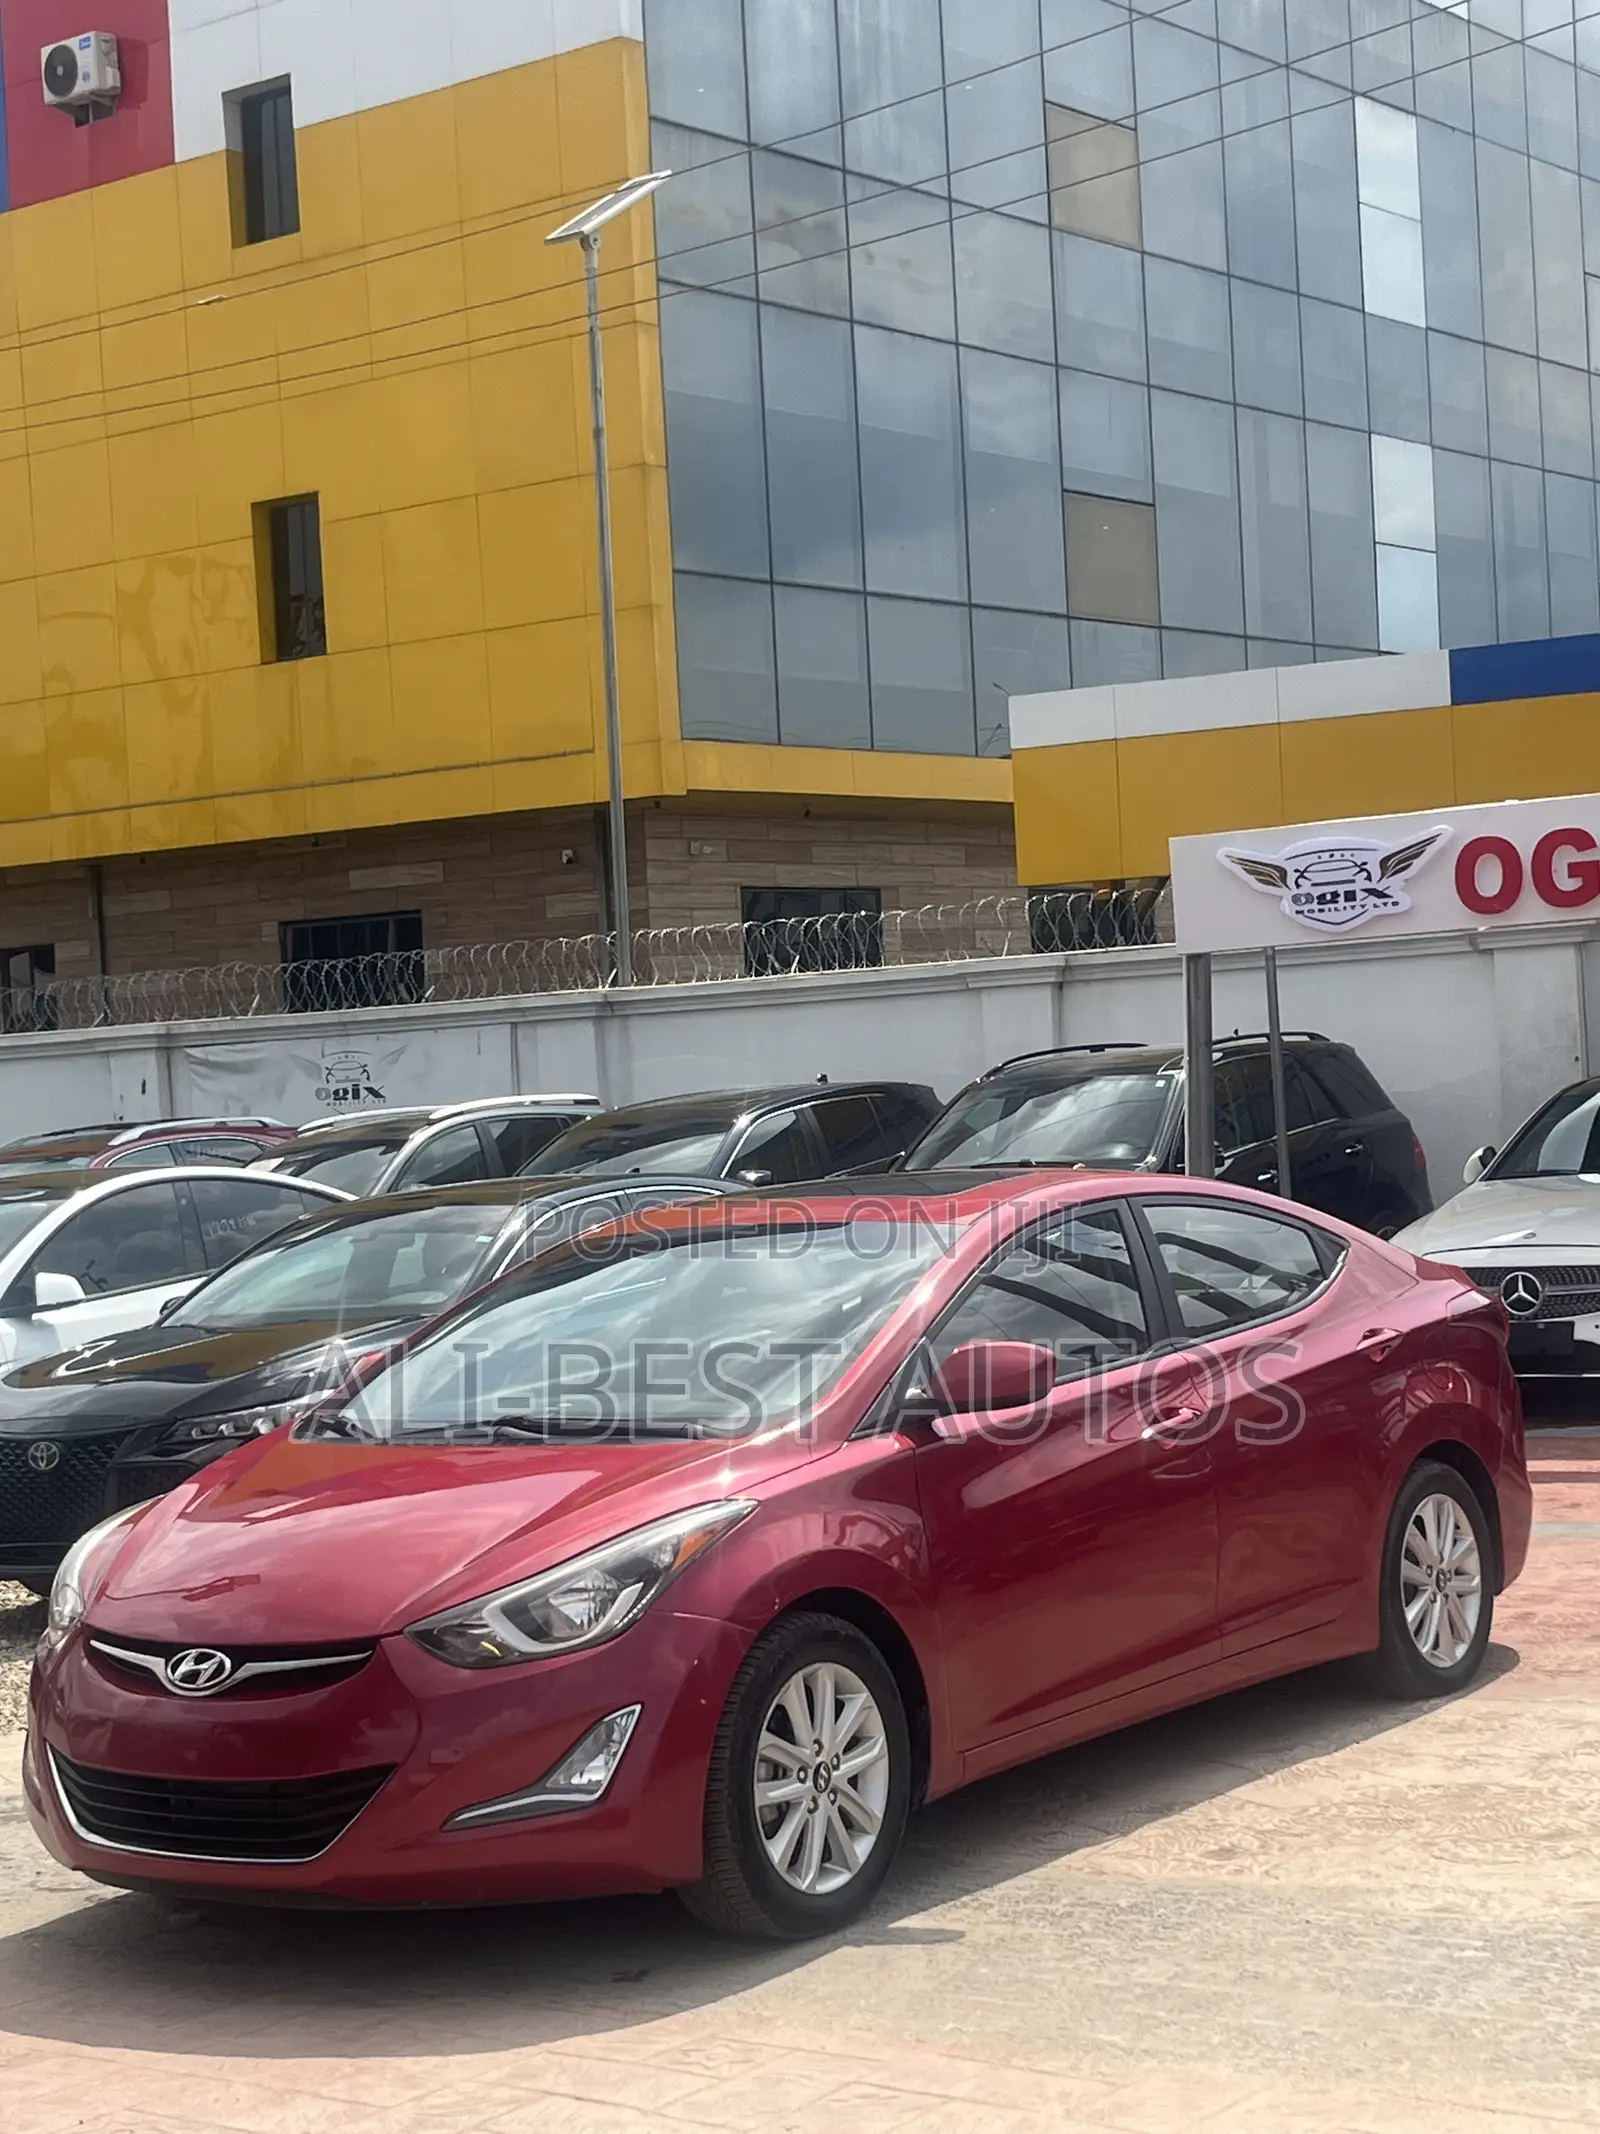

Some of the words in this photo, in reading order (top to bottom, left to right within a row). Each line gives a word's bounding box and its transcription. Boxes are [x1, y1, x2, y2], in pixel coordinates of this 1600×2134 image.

[1455, 827, 1600, 915] OG
[1295, 903, 1367, 915] MOBILITY
[1373, 901, 1400, 909] LTD
